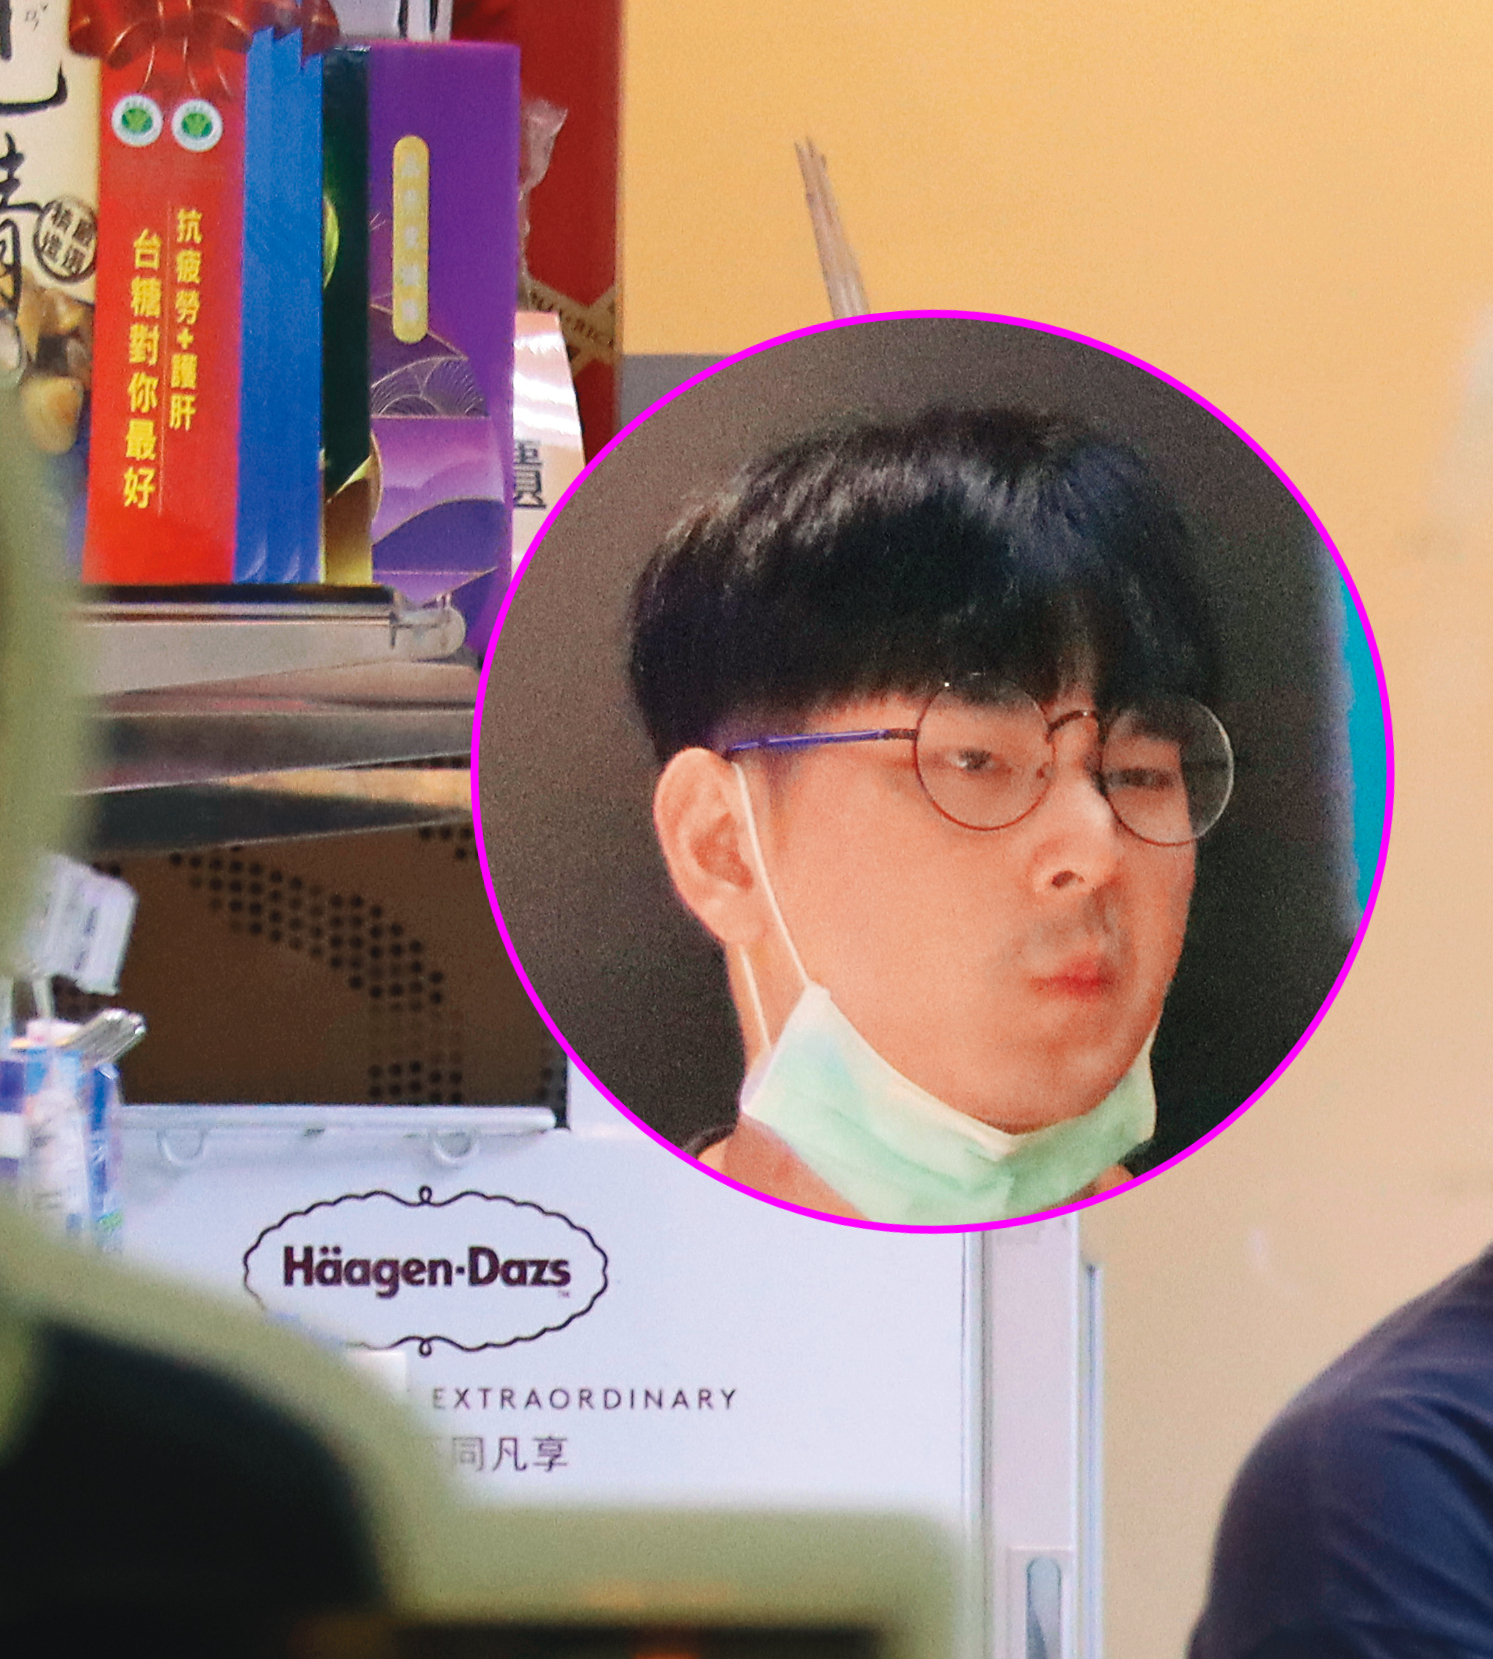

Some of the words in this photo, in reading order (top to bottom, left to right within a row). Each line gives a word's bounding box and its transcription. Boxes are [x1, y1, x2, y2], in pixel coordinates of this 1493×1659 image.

[170, 208, 203, 432] 抗疲勞+護肝
[123, 228, 163, 509] 台糖對你最好
[283, 1245, 571, 1299] Häagen-Dazs
[432, 1386, 737, 1411] EXTRAORDINARY
[440, 1436, 568, 1473] 同凡享
